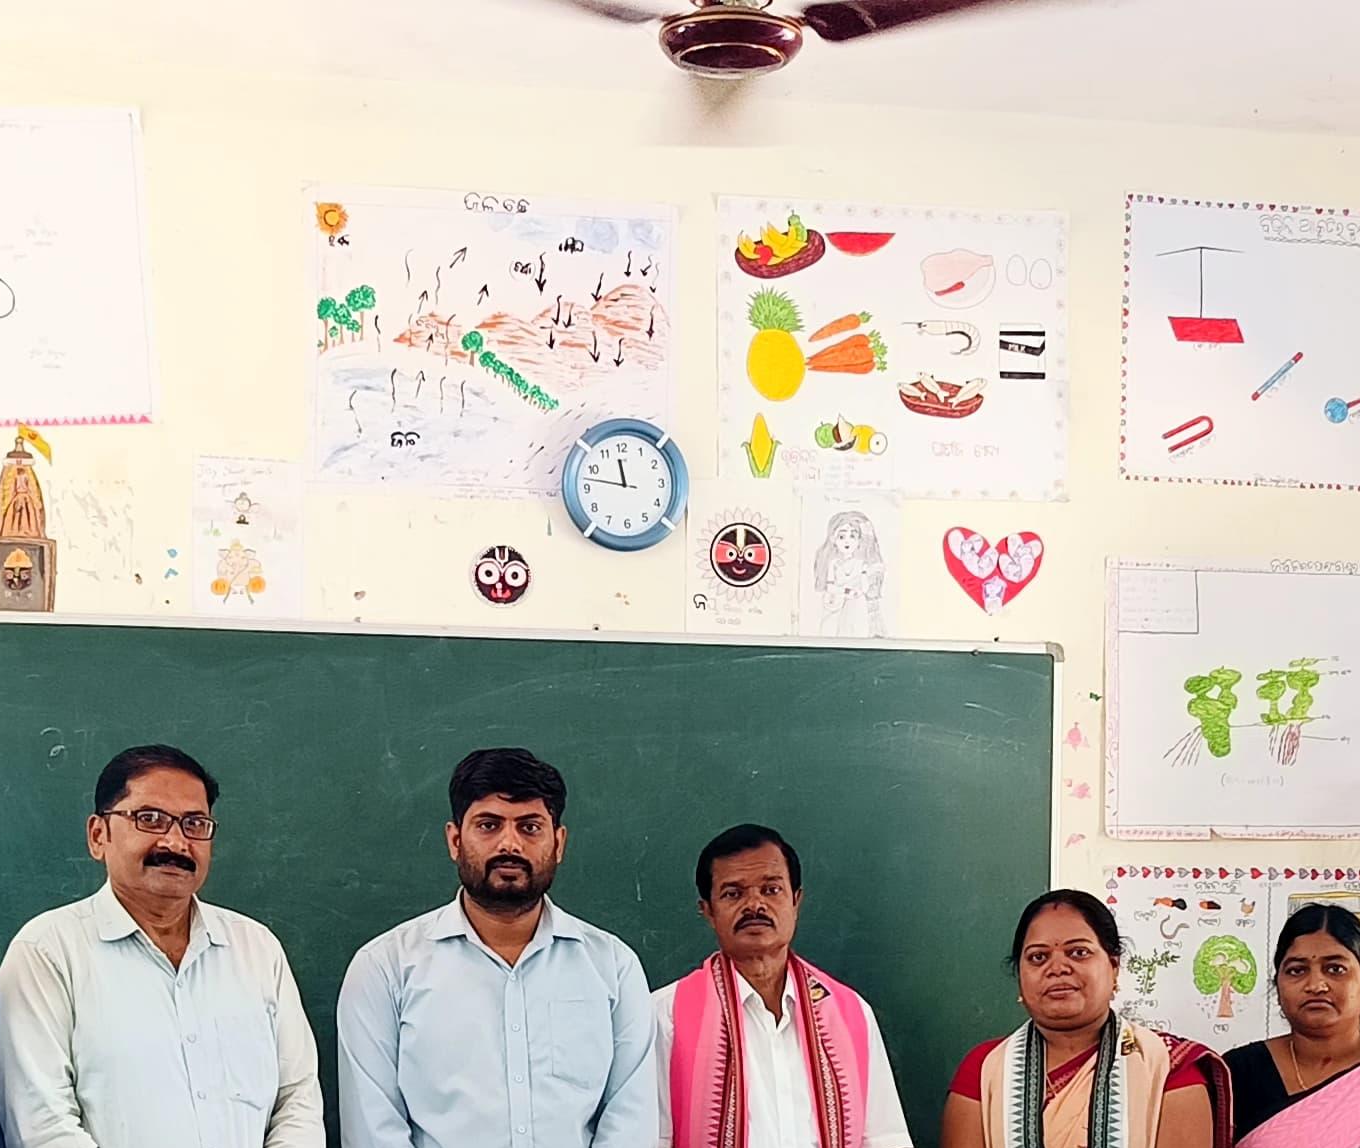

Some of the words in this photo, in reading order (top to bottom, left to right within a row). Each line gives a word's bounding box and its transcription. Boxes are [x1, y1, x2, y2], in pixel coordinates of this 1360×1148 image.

[615, 443, 628, 453] 12
[638, 447, 643, 457] 1
[600, 449, 610, 459] 11
[588, 464, 599, 475] 10
[651, 459, 658, 470] 2
[583, 483, 591, 494] 9
[658, 478, 665, 489] 3
[590, 502, 598, 513] 8
[653, 498, 661, 507] 4
[605, 515, 612, 525] 7
[641, 512, 649, 523] 5
[623, 518, 631, 529] 6
